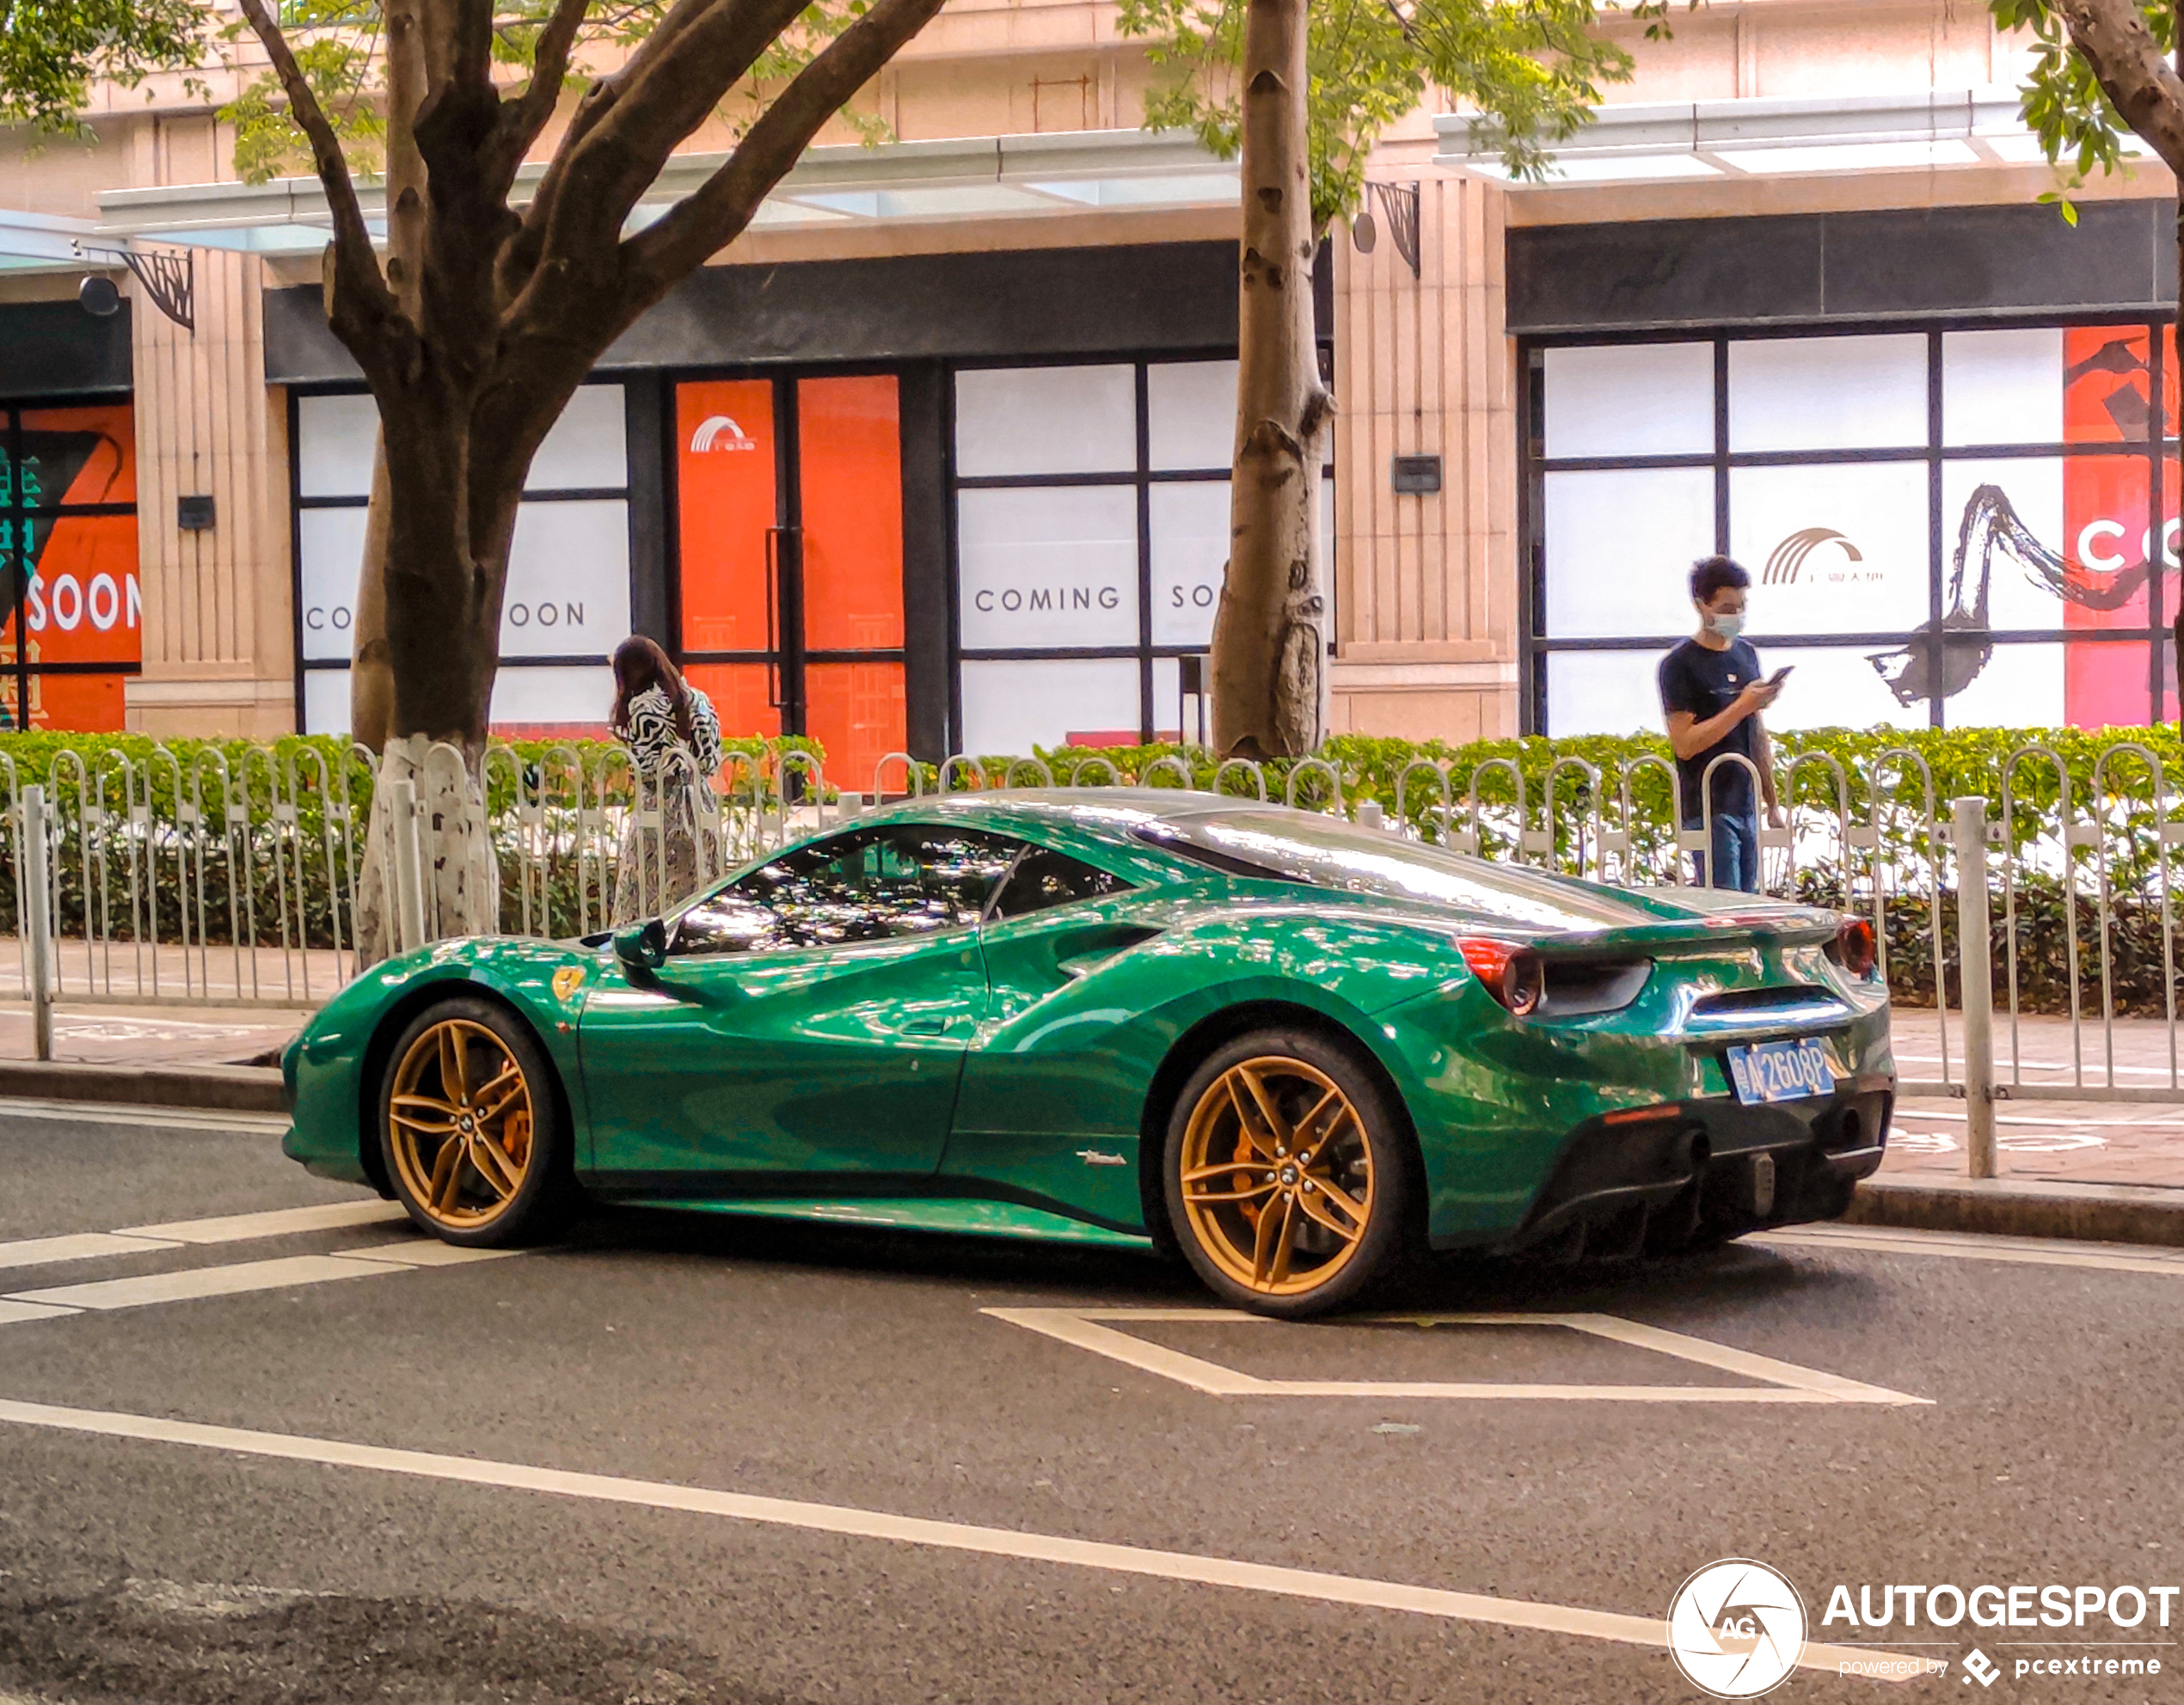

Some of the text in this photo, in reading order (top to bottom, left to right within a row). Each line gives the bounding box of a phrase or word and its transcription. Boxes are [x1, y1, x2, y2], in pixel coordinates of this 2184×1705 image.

[975, 585, 1213, 612] COMING SO
[509, 602, 584, 627] OON
